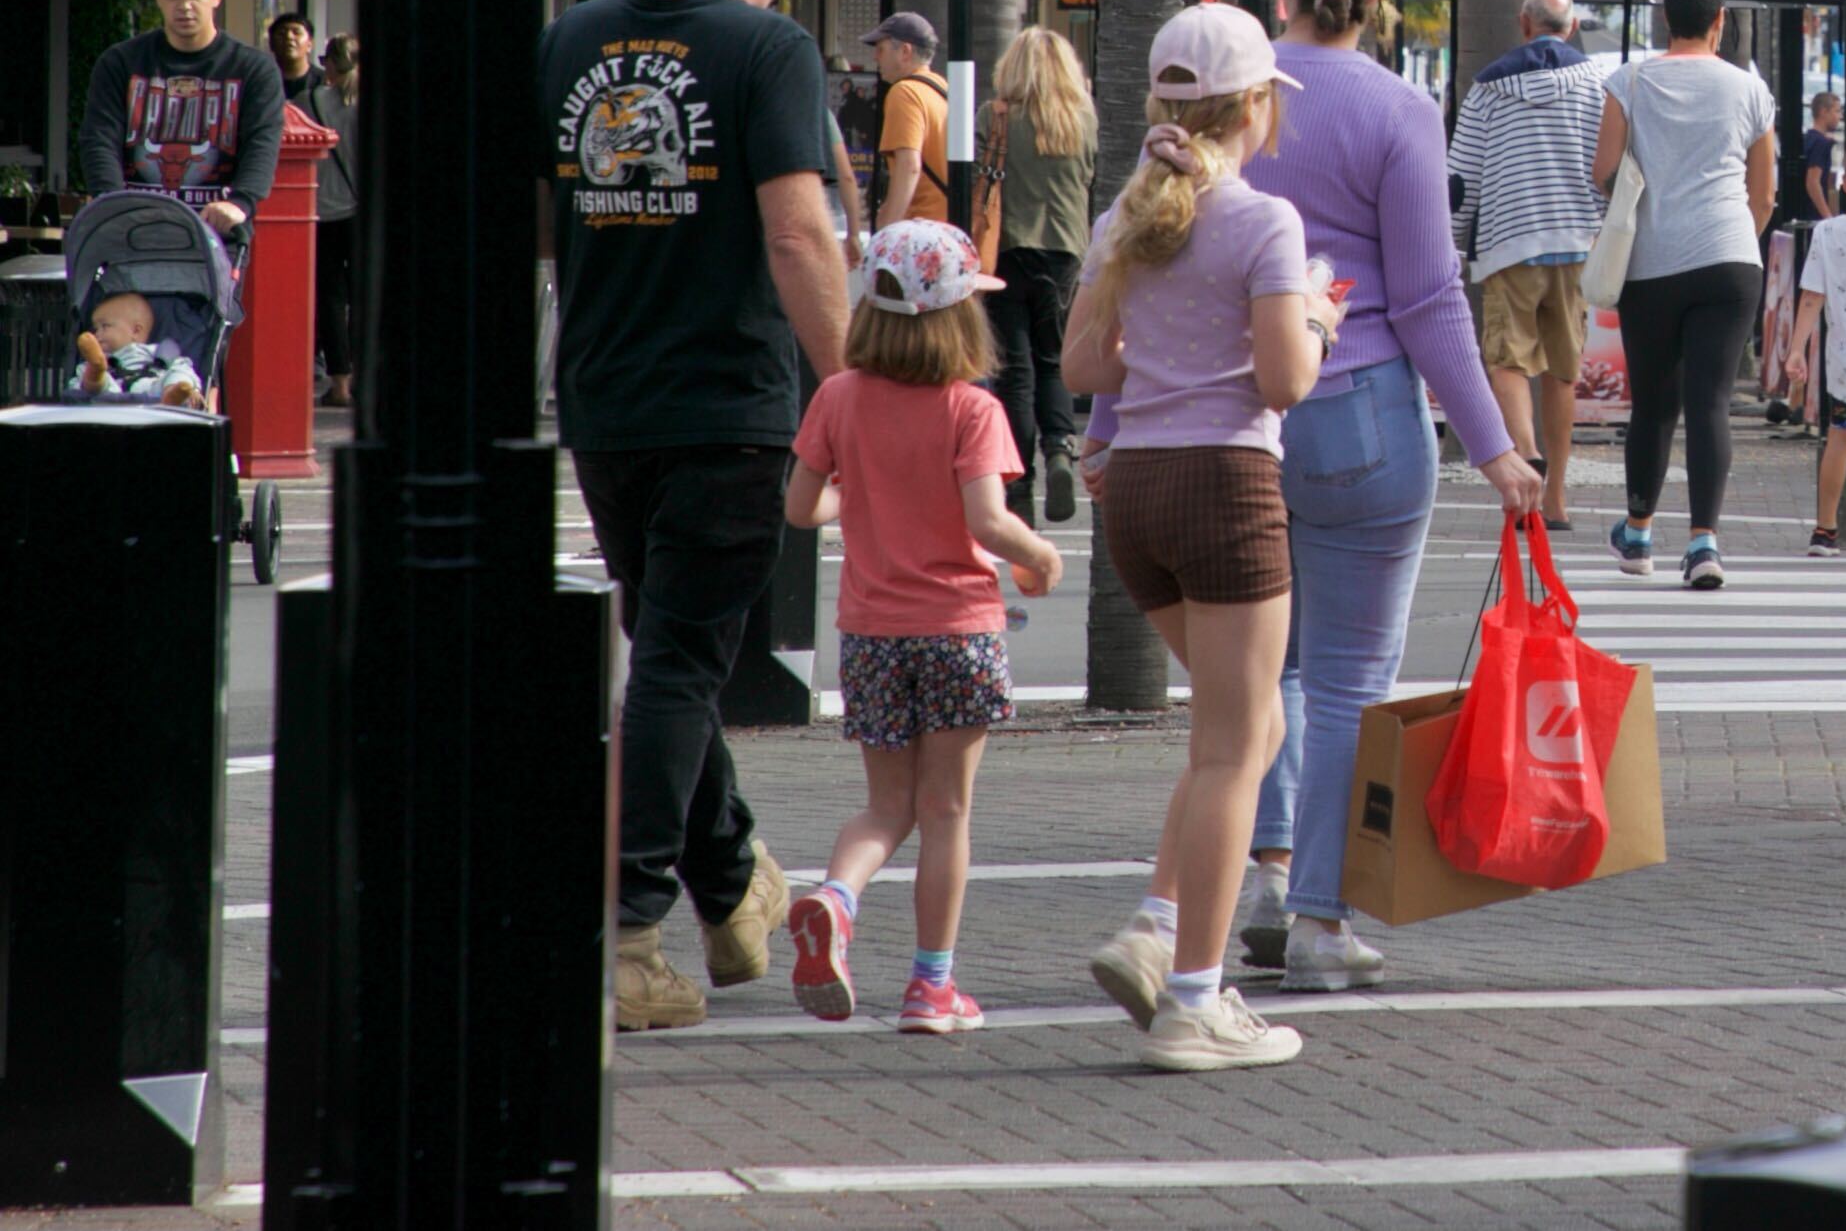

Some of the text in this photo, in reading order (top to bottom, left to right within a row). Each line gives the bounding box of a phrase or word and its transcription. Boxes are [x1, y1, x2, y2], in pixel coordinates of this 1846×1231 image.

[602, 41, 625, 57] THE
[126, 74, 242, 155] CHAMPS
[558, 57, 624, 152] CAUGHT
[683, 102, 716, 156] ALL
[687, 165, 719, 181] 2012
[573, 190, 698, 214] FISHING CLUB
